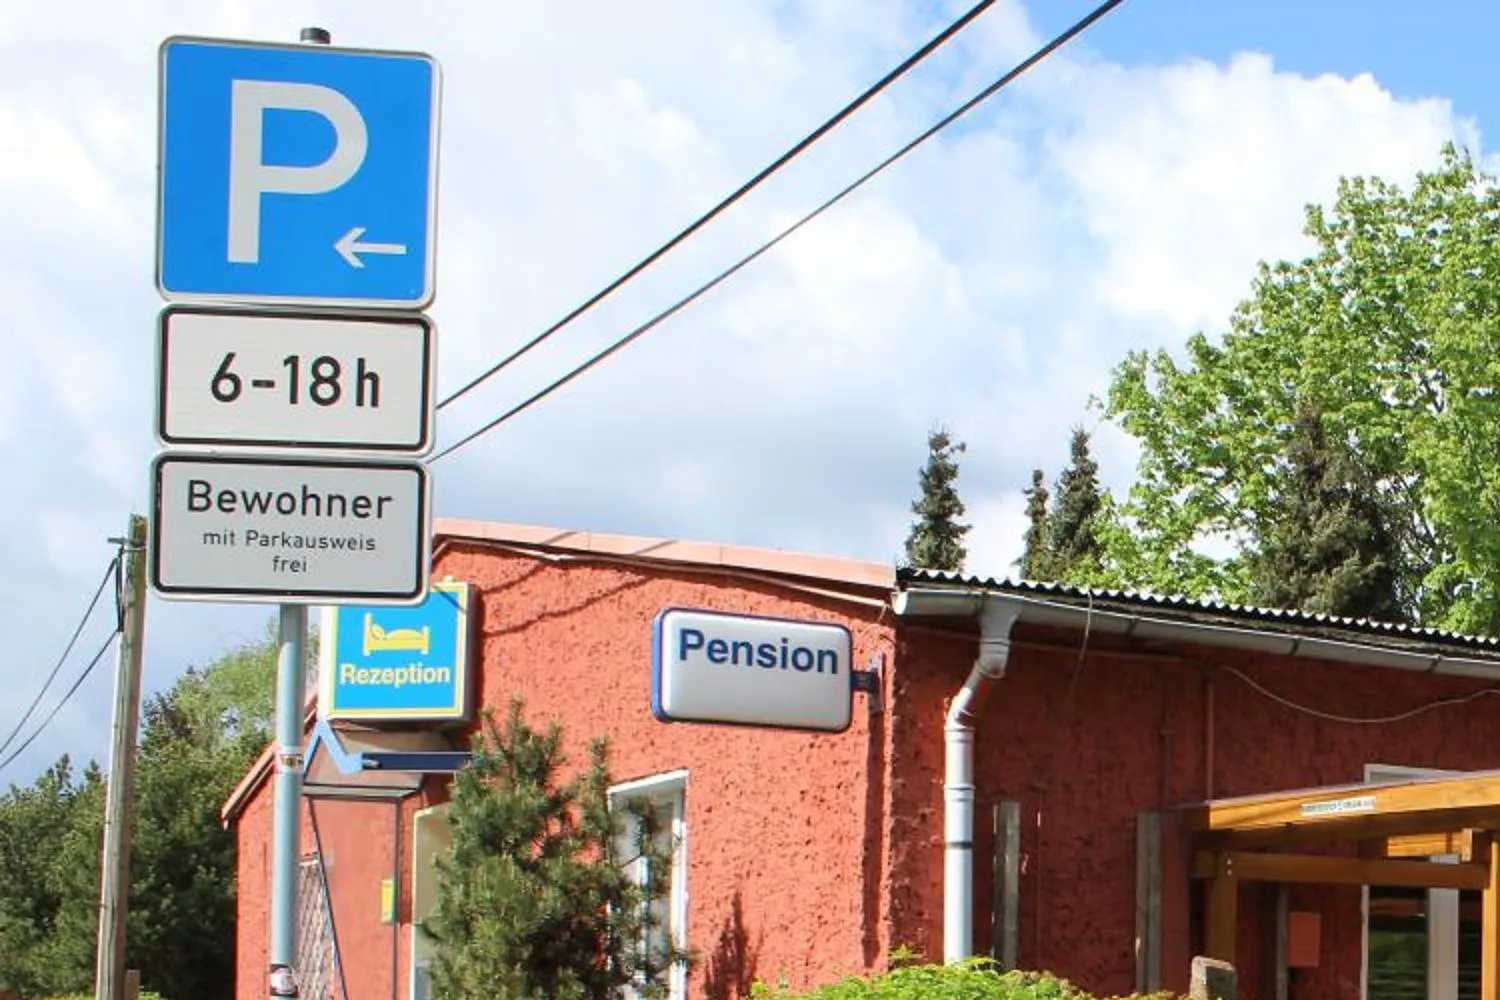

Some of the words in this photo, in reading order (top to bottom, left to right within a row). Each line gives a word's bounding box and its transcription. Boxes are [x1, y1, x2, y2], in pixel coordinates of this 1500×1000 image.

[227, 79, 368, 263] P
[187, 480, 393, 519] Bewohner
[203, 529, 235, 547] mit
[246, 529, 376, 552] Parkausweis
[272, 555, 308, 574] frei
[679, 628, 838, 675] Pension
[340, 663, 450, 686] Rezeption
